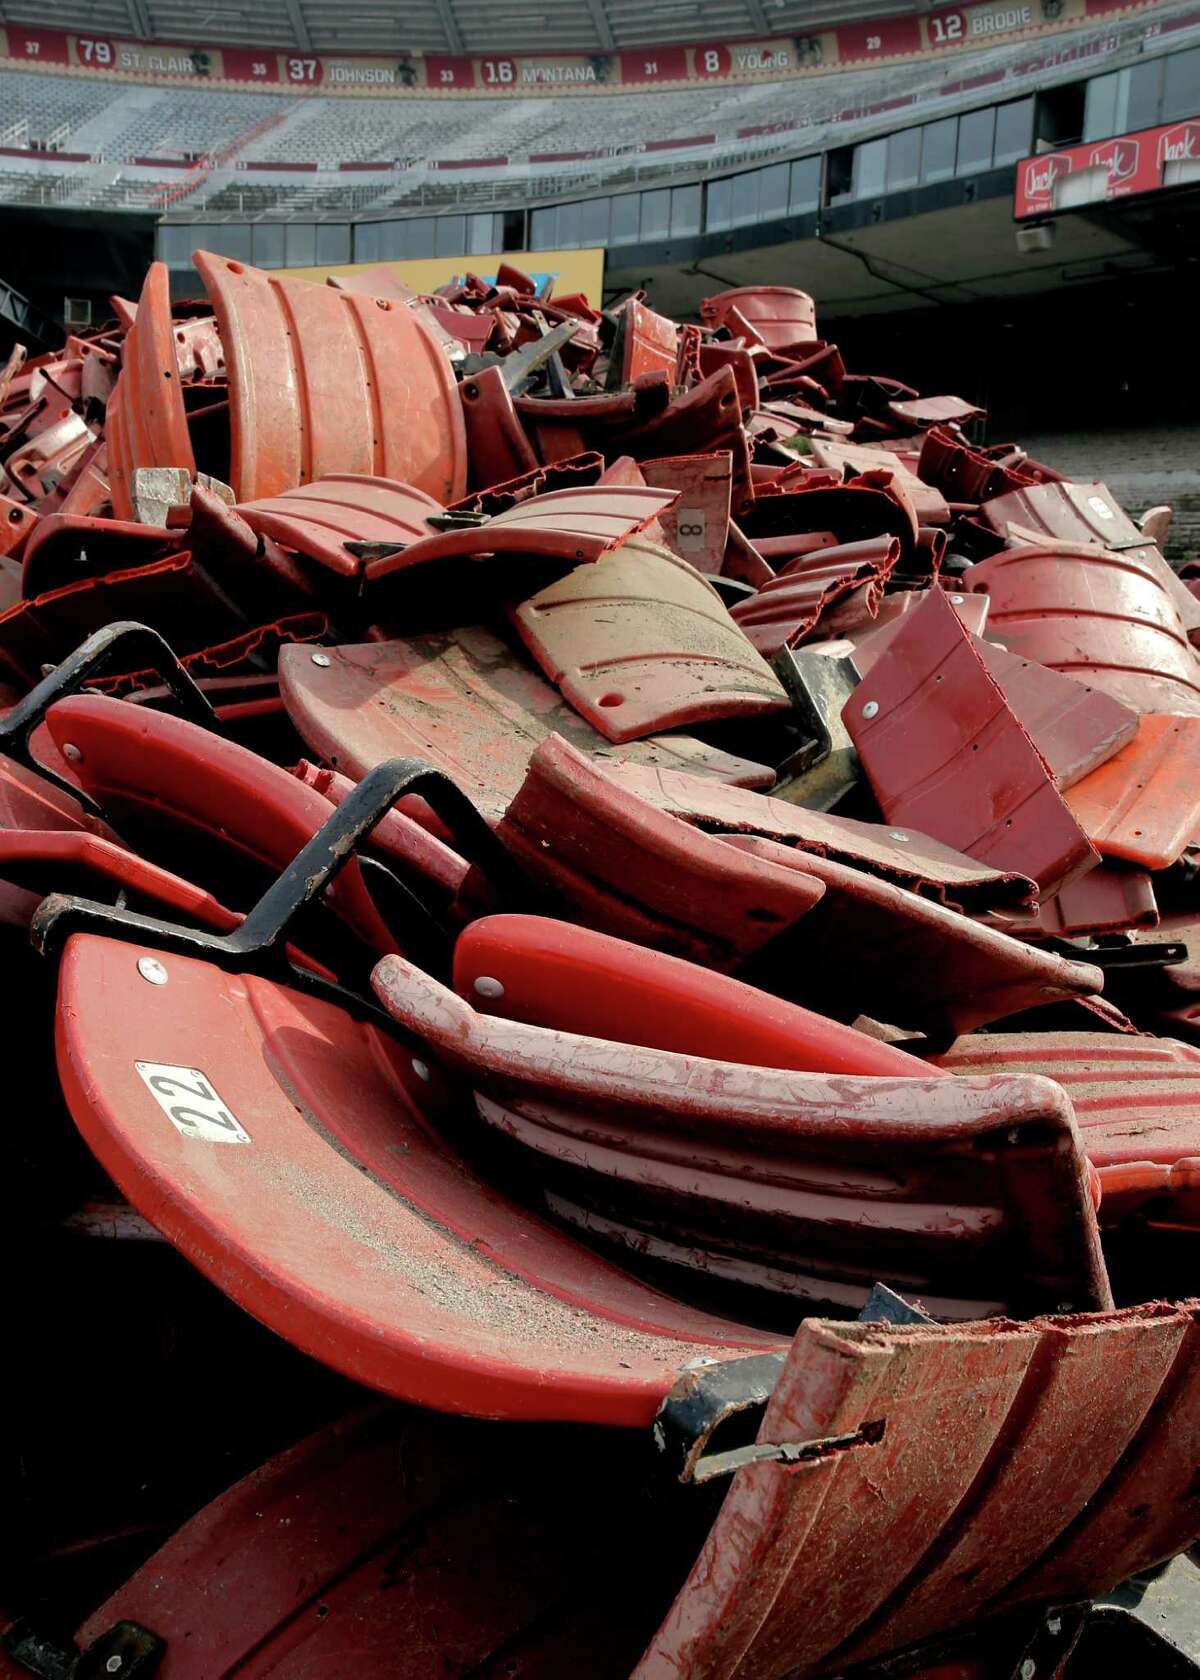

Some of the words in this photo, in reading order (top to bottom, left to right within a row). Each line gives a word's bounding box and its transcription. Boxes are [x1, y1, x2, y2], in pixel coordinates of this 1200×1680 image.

[932, 14, 963, 42] 12
[972, 7, 1031, 34] BRODIE
[80, 39, 111, 63] 79
[150, 55, 193, 72] CLAIR
[704, 50, 720, 72] 8
[288, 59, 317, 80] 37
[329, 67, 395, 83] JOHNSON
[485, 62, 513, 82] 16
[679, 524, 703, 537] 8
[149, 1075, 238, 1131] 22
